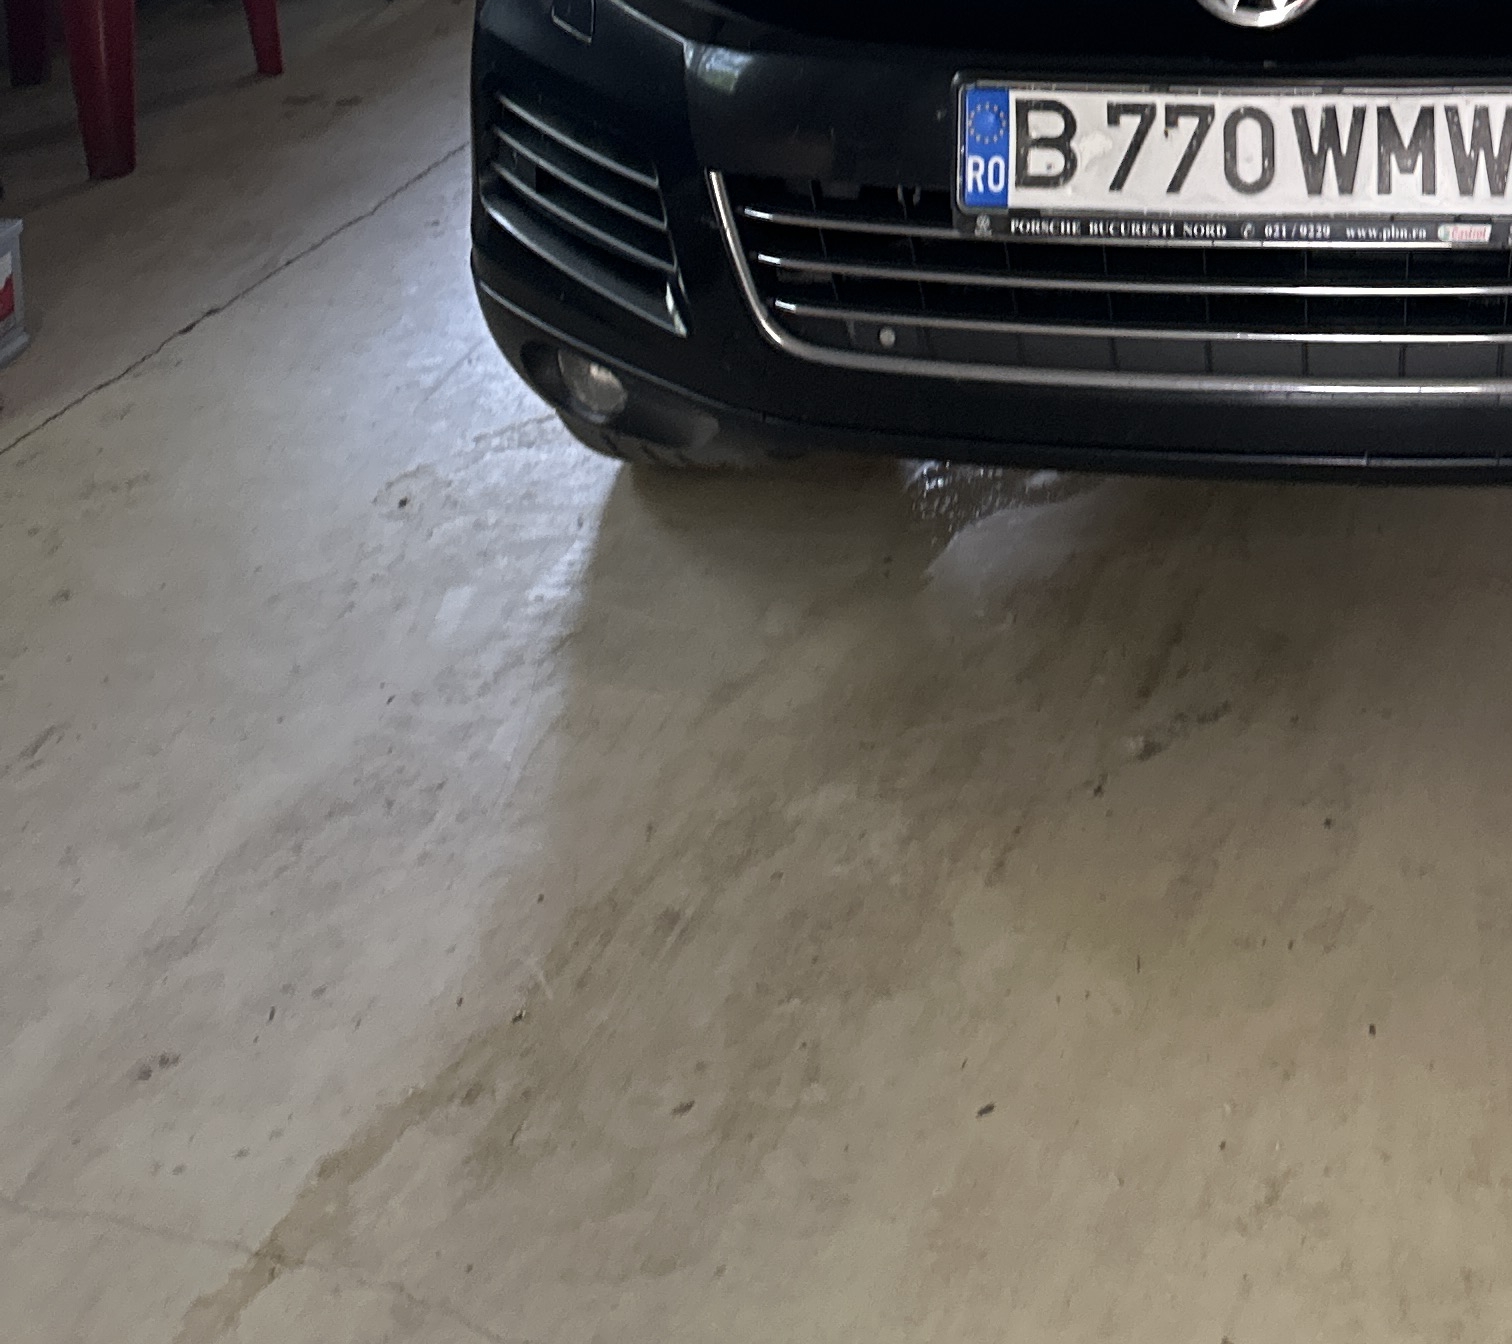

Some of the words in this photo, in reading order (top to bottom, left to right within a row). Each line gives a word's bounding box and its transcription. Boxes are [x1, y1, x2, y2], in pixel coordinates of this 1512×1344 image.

[1014, 99, 1078, 188] B
[1106, 103, 1275, 195] 770
[965, 156, 1005, 193] RO
[1010, 218, 1081, 235] PORSCHE
[1088, 220, 1175, 238] BUCURESTI
[1182, 222, 1227, 239] NORD
